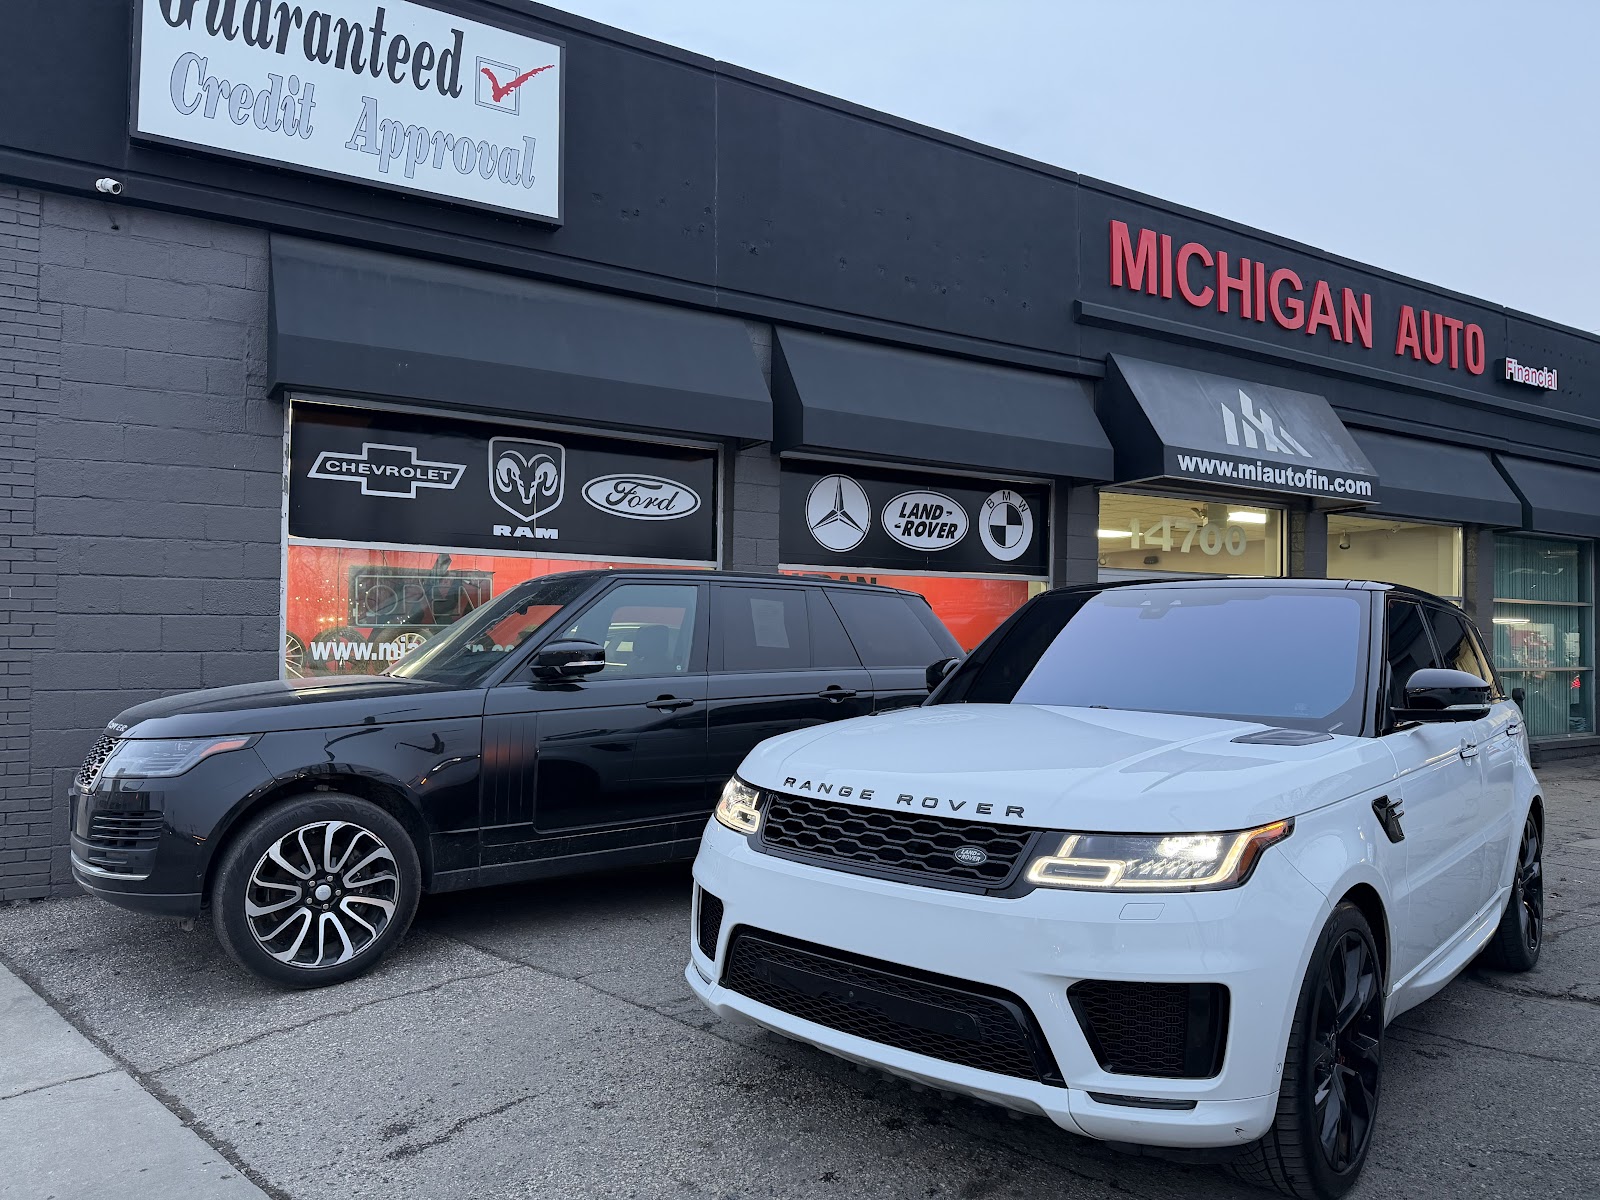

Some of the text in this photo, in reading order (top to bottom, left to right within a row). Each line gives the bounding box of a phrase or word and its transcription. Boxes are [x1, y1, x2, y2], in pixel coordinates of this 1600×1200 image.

[170, 51, 537, 190] Credit Approval
[1110, 220, 1486, 375] MICHIGAN AUTO
[1505, 356, 1558, 390] Financial
[325, 459, 453, 482] CHEVROLET
[1177, 454, 1372, 496] www.miautofin.com
[604, 480, 678, 513] Ford
[986, 490, 1029, 513] BMW
[493, 524, 559, 540] RAM
[1127, 514, 1247, 556] 14700
[365, 583, 482, 616] OPEN
[783, 776, 1025, 819] RANGE ROVER
